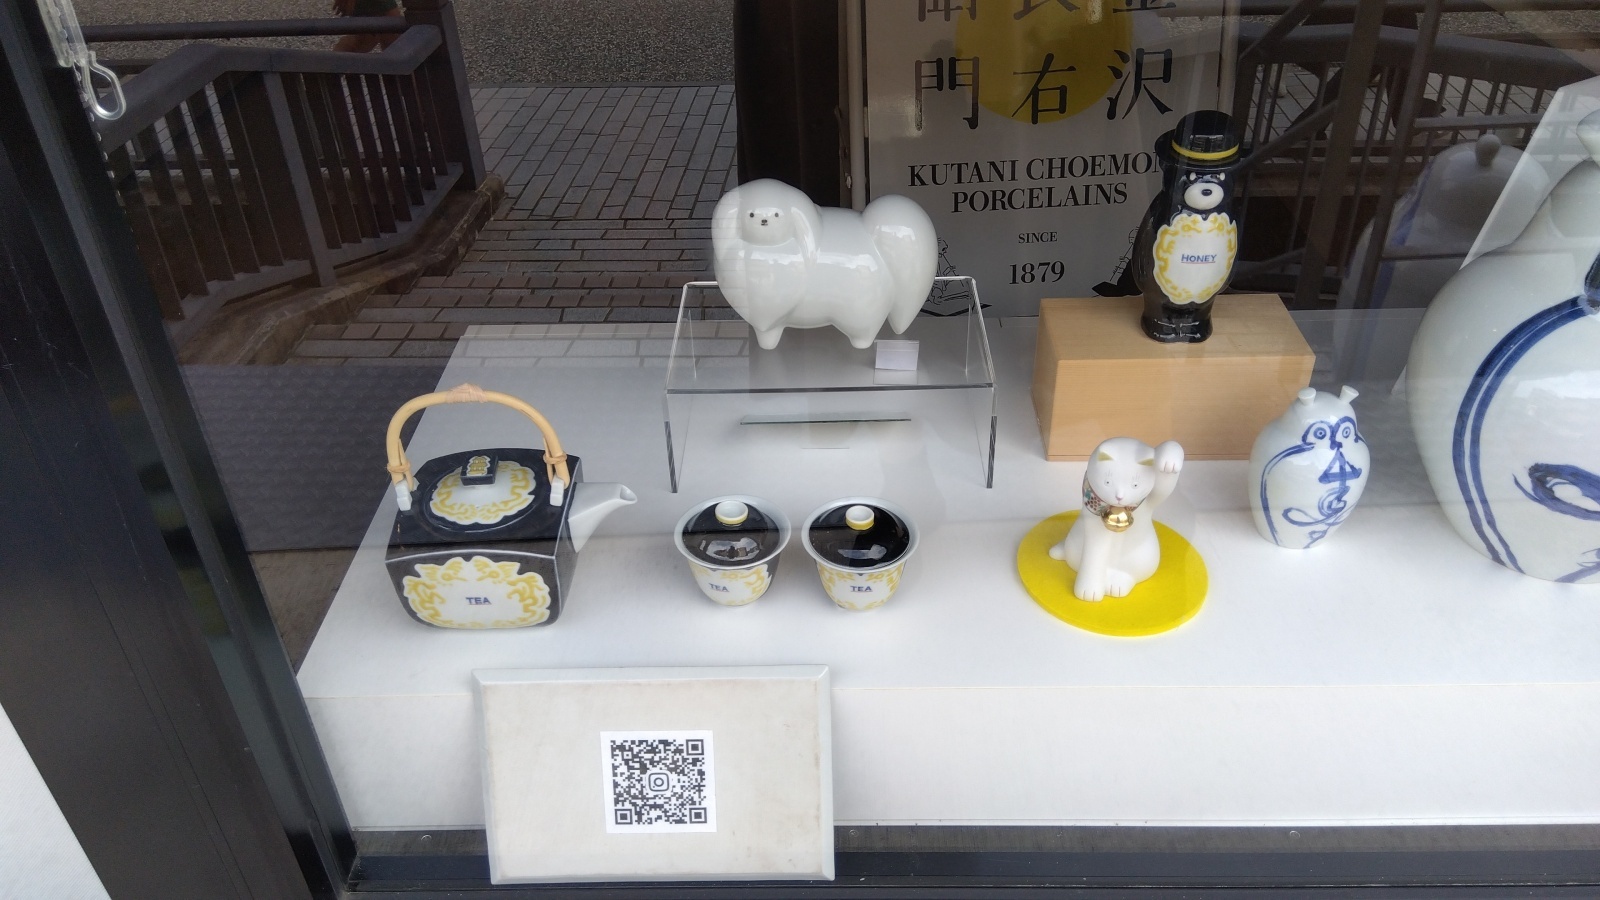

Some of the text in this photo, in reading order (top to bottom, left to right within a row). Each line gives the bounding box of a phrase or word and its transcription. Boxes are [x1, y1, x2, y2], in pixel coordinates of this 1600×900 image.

[908, 160, 1018, 187] KUTANI
[951, 182, 1128, 213] PORCELAINS
[1018, 231, 1058, 244] SINCE
[1181, 254, 1217, 263] HONEY
[1009, 260, 1065, 285] 1879
[708, 583, 729, 592] TEA
[465, 597, 492, 605] TEA
